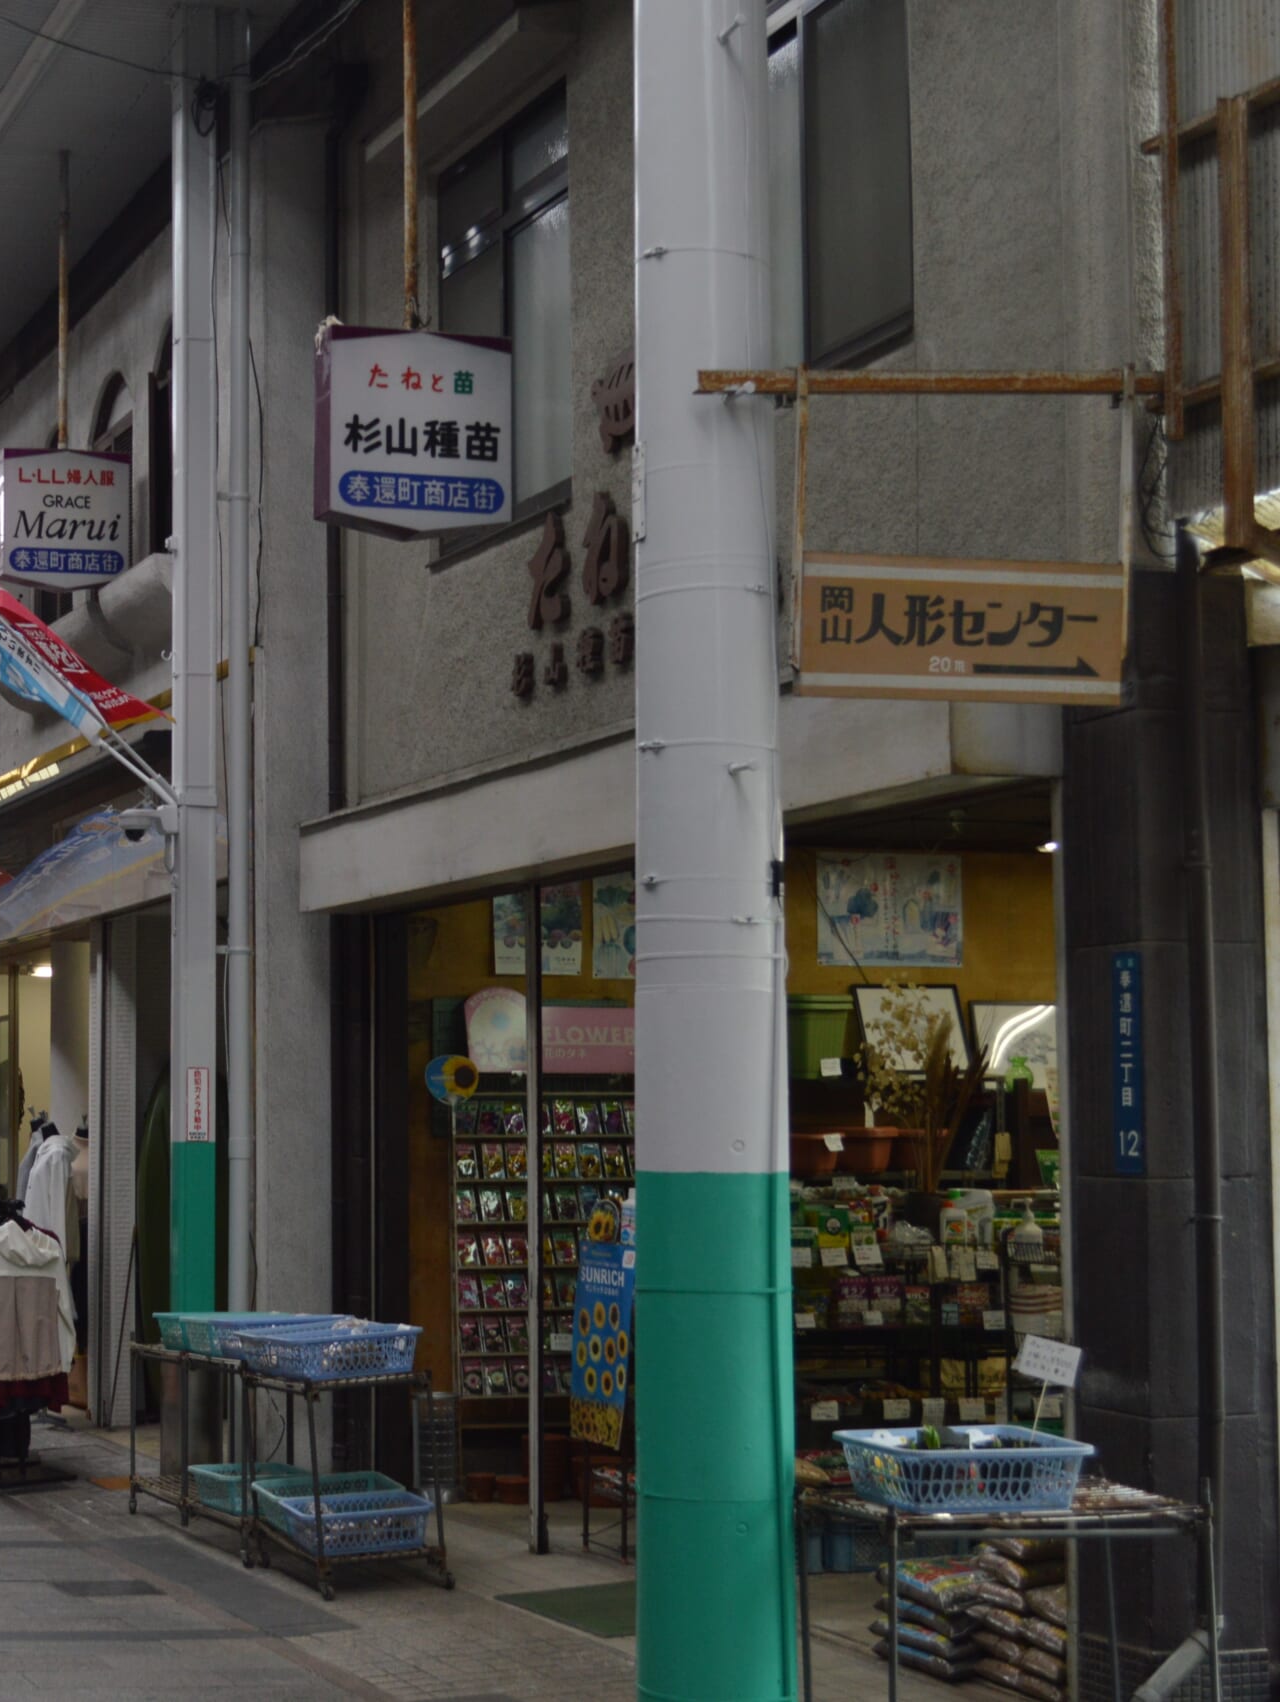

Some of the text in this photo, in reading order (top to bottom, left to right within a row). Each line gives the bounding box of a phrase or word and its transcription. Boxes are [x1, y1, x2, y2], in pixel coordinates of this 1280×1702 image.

[368, 364, 474, 395] たねと苗
[344, 413, 501, 462] 杉山種苗
[42, 495, 92, 510] GRACE
[347, 474, 496, 510] 奉還町商店街
[14, 509, 121, 543] Marui
[14, 551, 119, 574] 奉還町商店街
[821, 585, 854, 645] 岡山
[855, 592, 1098, 647] 人形センター
[1119, 1130, 1139, 1157] 12
[581, 1266, 625, 1288] SUNRICH
